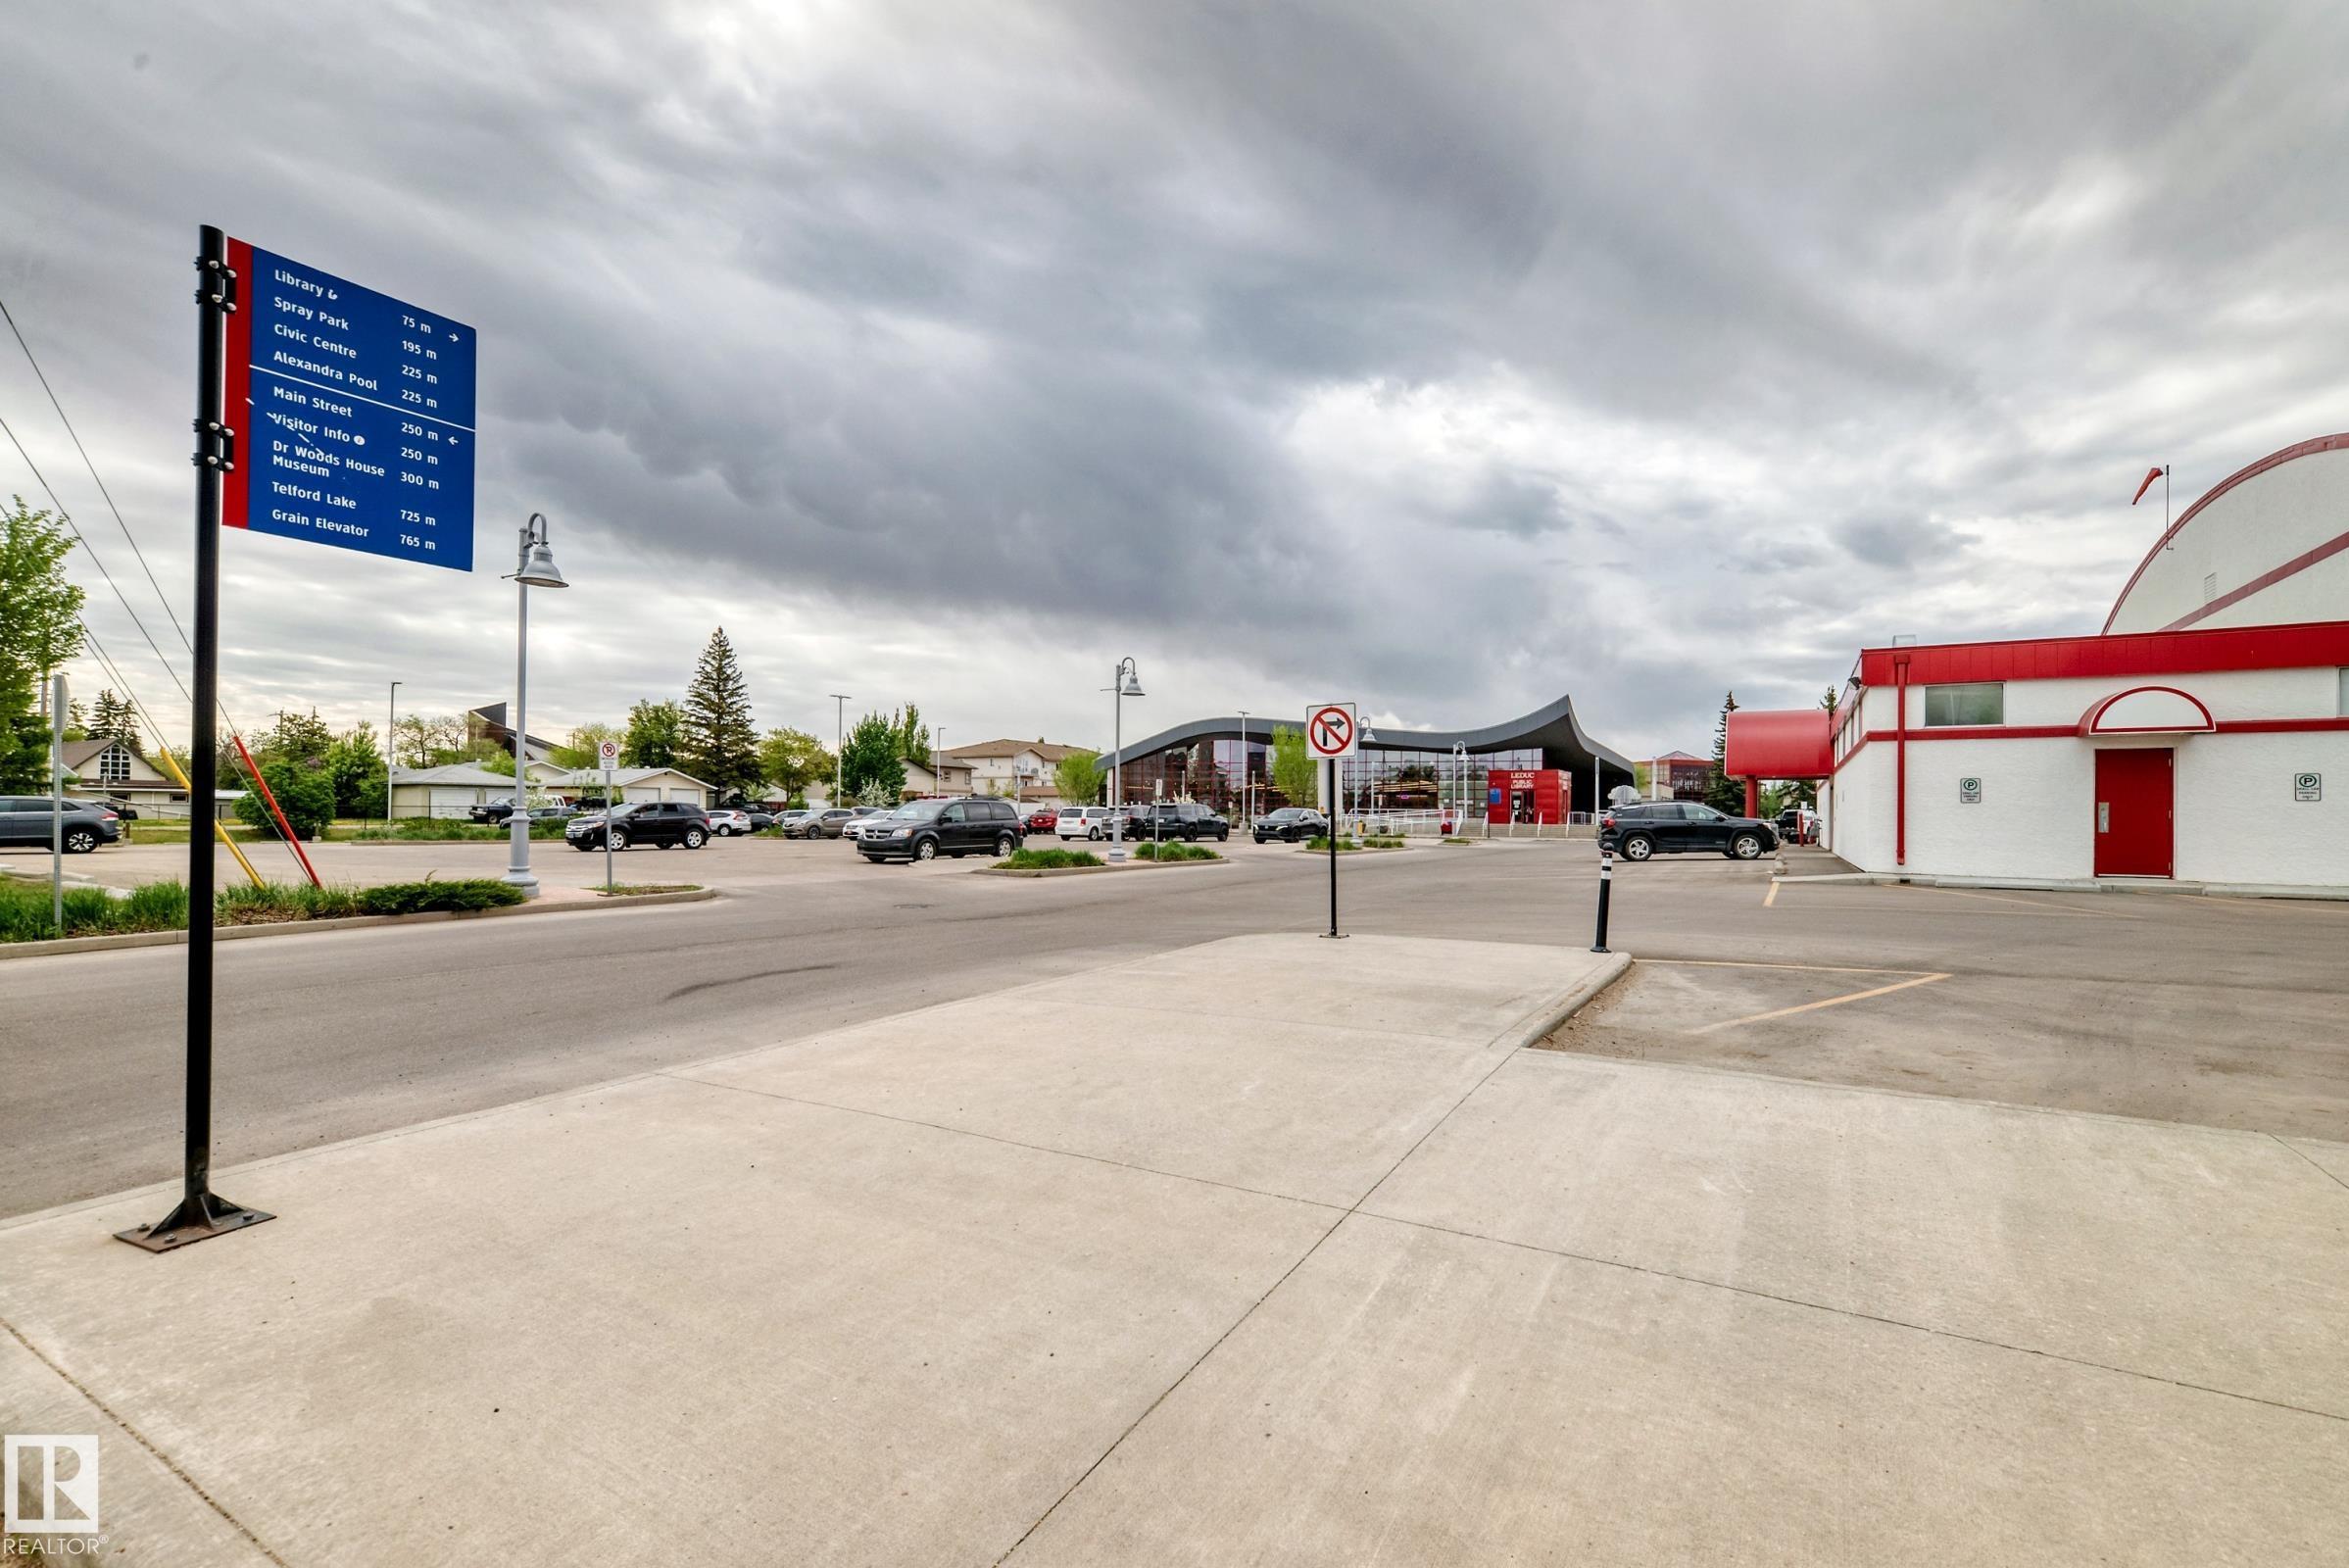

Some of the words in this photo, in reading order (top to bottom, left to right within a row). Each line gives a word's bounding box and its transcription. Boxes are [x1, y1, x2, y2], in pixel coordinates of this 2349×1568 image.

[273, 296, 314, 320] Spray
[318, 311, 350, 331] Park
[402, 340, 421, 355] 195
[426, 349, 437, 361] m
[274, 269, 324, 297] Library
[402, 315, 416, 328] 75
[420, 322, 431, 334] m
[273, 351, 343, 380] Alexandra
[349, 372, 378, 391] Pool
[401, 389, 421, 404] 225
[426, 398, 437, 409] m
[274, 323, 308, 343] Civic
[313, 336, 357, 359] Centre
[401, 364, 422, 379] 225
[426, 373, 438, 384] m
[273, 386, 307, 405] Main
[312, 397, 353, 417] Street
[401, 422, 422, 437] 250
[427, 430, 439, 441] m
[273, 413, 318, 433] Visitor
[323, 426, 350, 443] Info
[401, 447, 422, 462] 250
[427, 455, 438, 466] m
[272, 455, 329, 477] Museum
[273, 440, 289, 454] Dr
[294, 445, 340, 466] Woods
[345, 458, 385, 477] House
[400, 471, 423, 486] 300
[428, 479, 439, 490] m
[271, 481, 320, 502] Telford
[326, 493, 357, 510] Lake
[400, 510, 420, 522] 725
[424, 515, 436, 526] m
[271, 509, 310, 526] Grain
[316, 517, 369, 537] Elevator
[400, 534, 420, 547] 765
[424, 540, 436, 551] m
